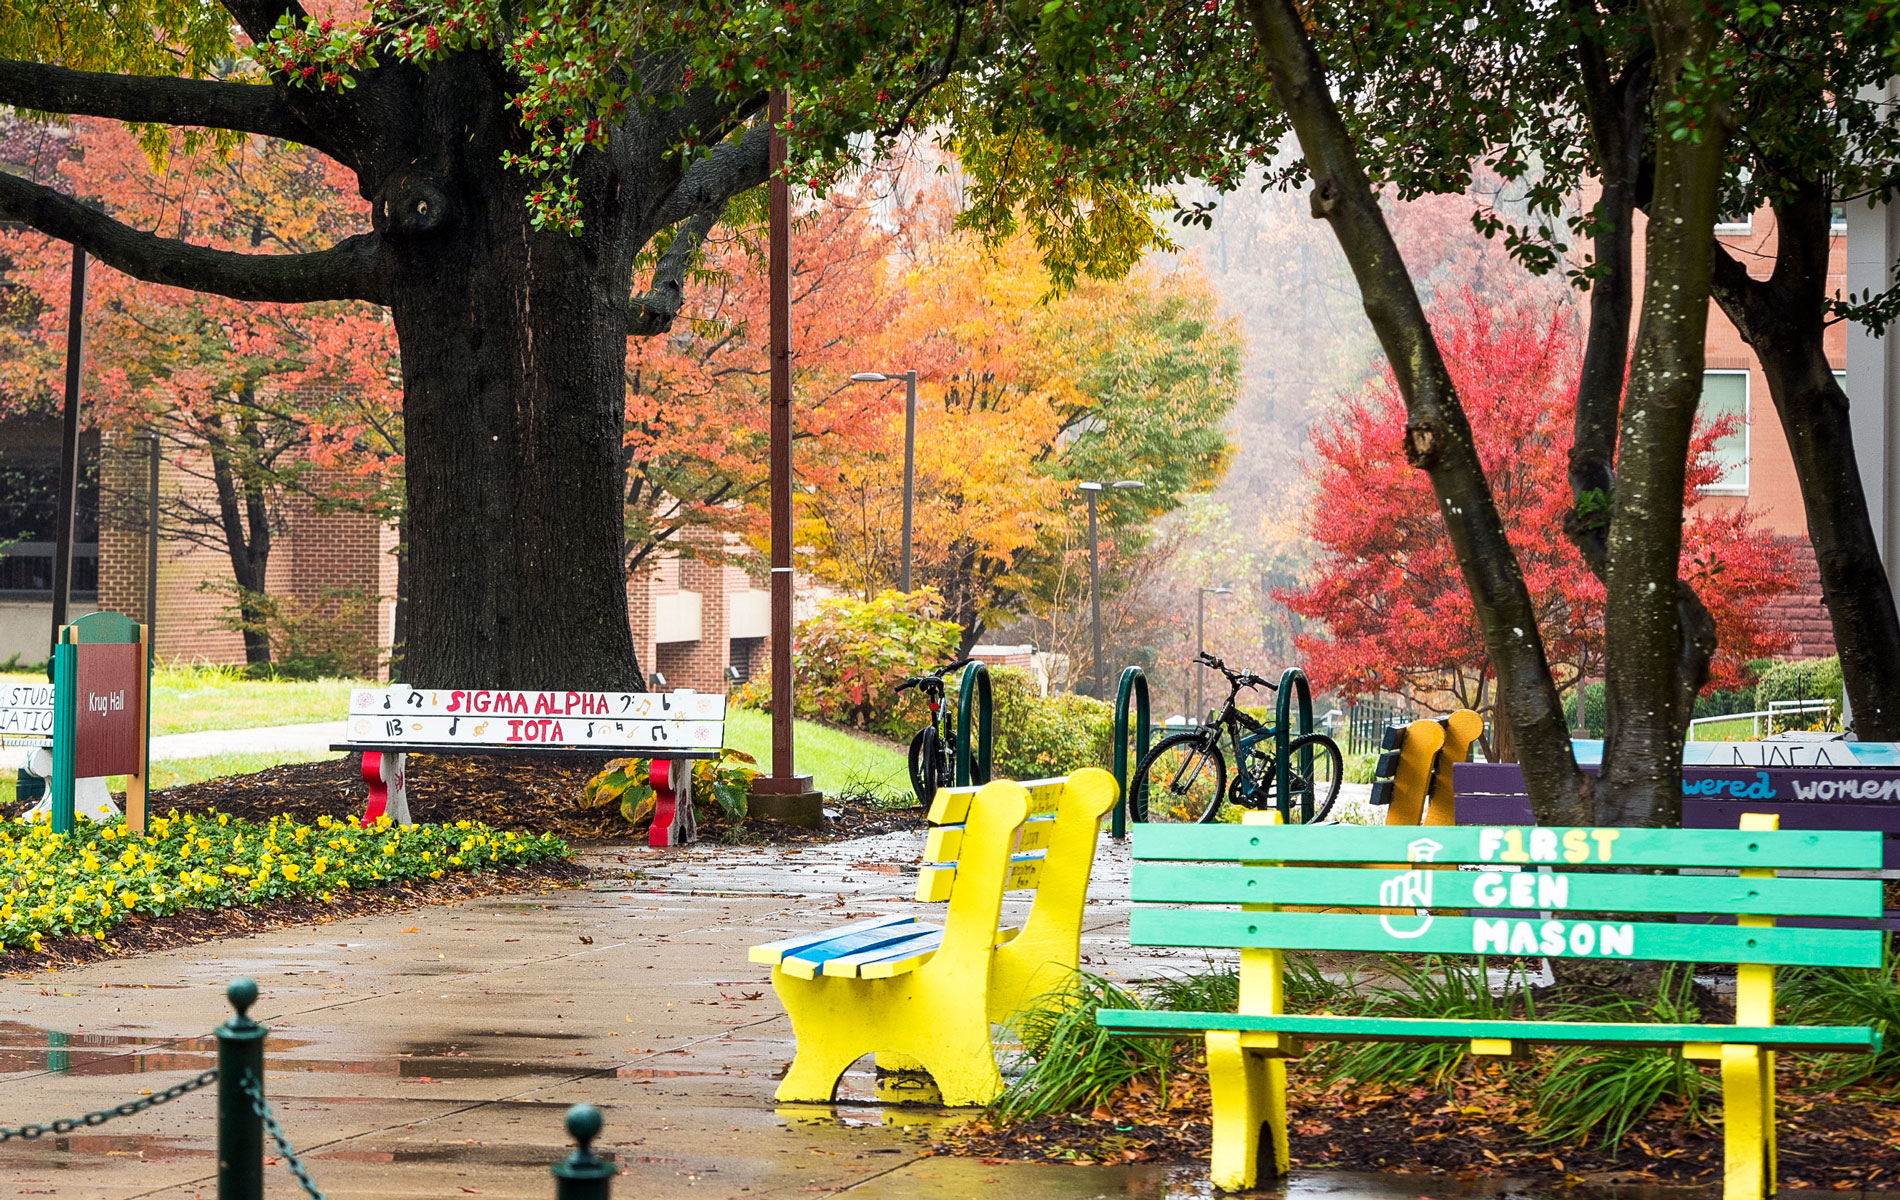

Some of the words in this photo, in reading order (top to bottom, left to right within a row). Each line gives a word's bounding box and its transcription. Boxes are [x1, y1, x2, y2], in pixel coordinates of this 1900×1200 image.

[89, 691, 108, 717] Krug
[110, 689, 125, 711] Hall
[446, 690, 529, 714] SIGMA
[534, 691, 610, 716] ALPHA
[506, 719, 564, 742] IOTA
[1472, 871, 1569, 909] GEN
[1472, 918, 1635, 957] MASON
